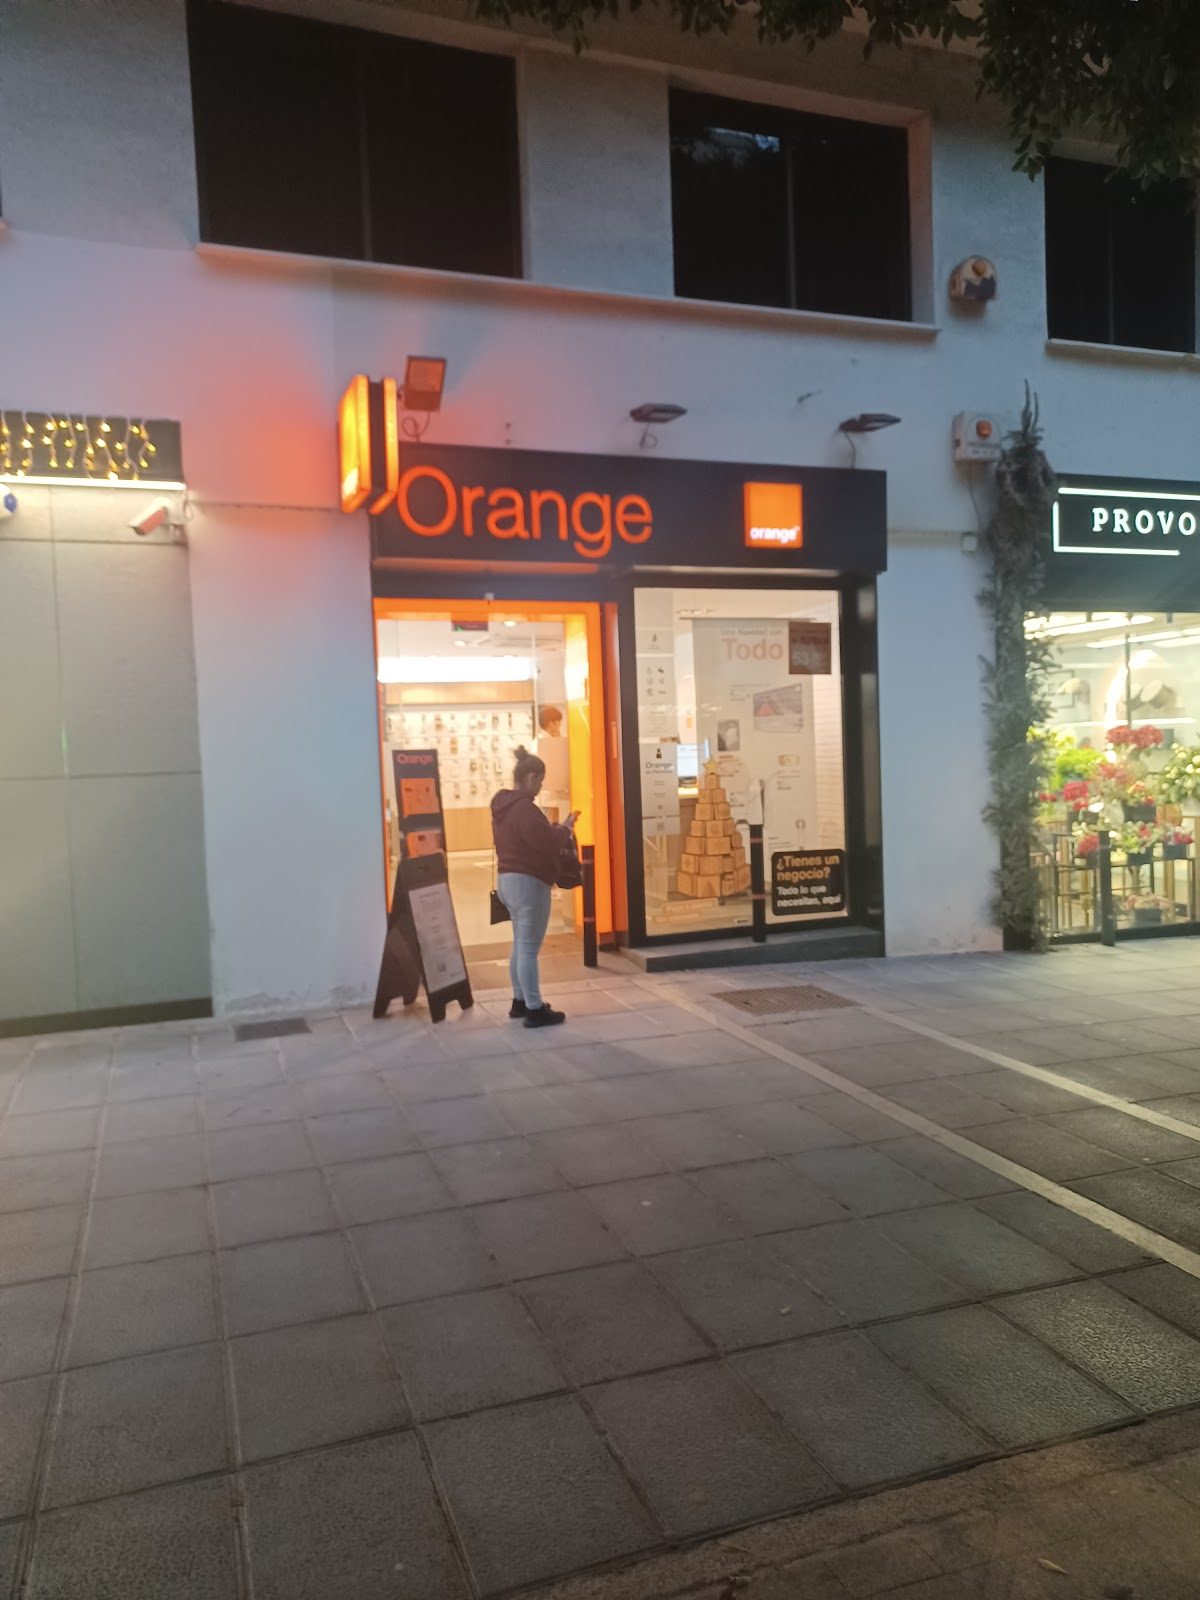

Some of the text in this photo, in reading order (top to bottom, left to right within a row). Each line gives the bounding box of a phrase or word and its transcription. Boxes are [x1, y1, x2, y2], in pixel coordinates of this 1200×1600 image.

[397, 465, 653, 558] Orange
[1092, 507, 1197, 536] PROVO
[750, 527, 798, 544] orange
[720, 638, 783, 661] Todo
[397, 753, 434, 766] Orange
[777, 855, 840, 871] ¿Tienes un
[777, 866, 831, 883] negocio?
[777, 885, 827, 896] Todo lo que
